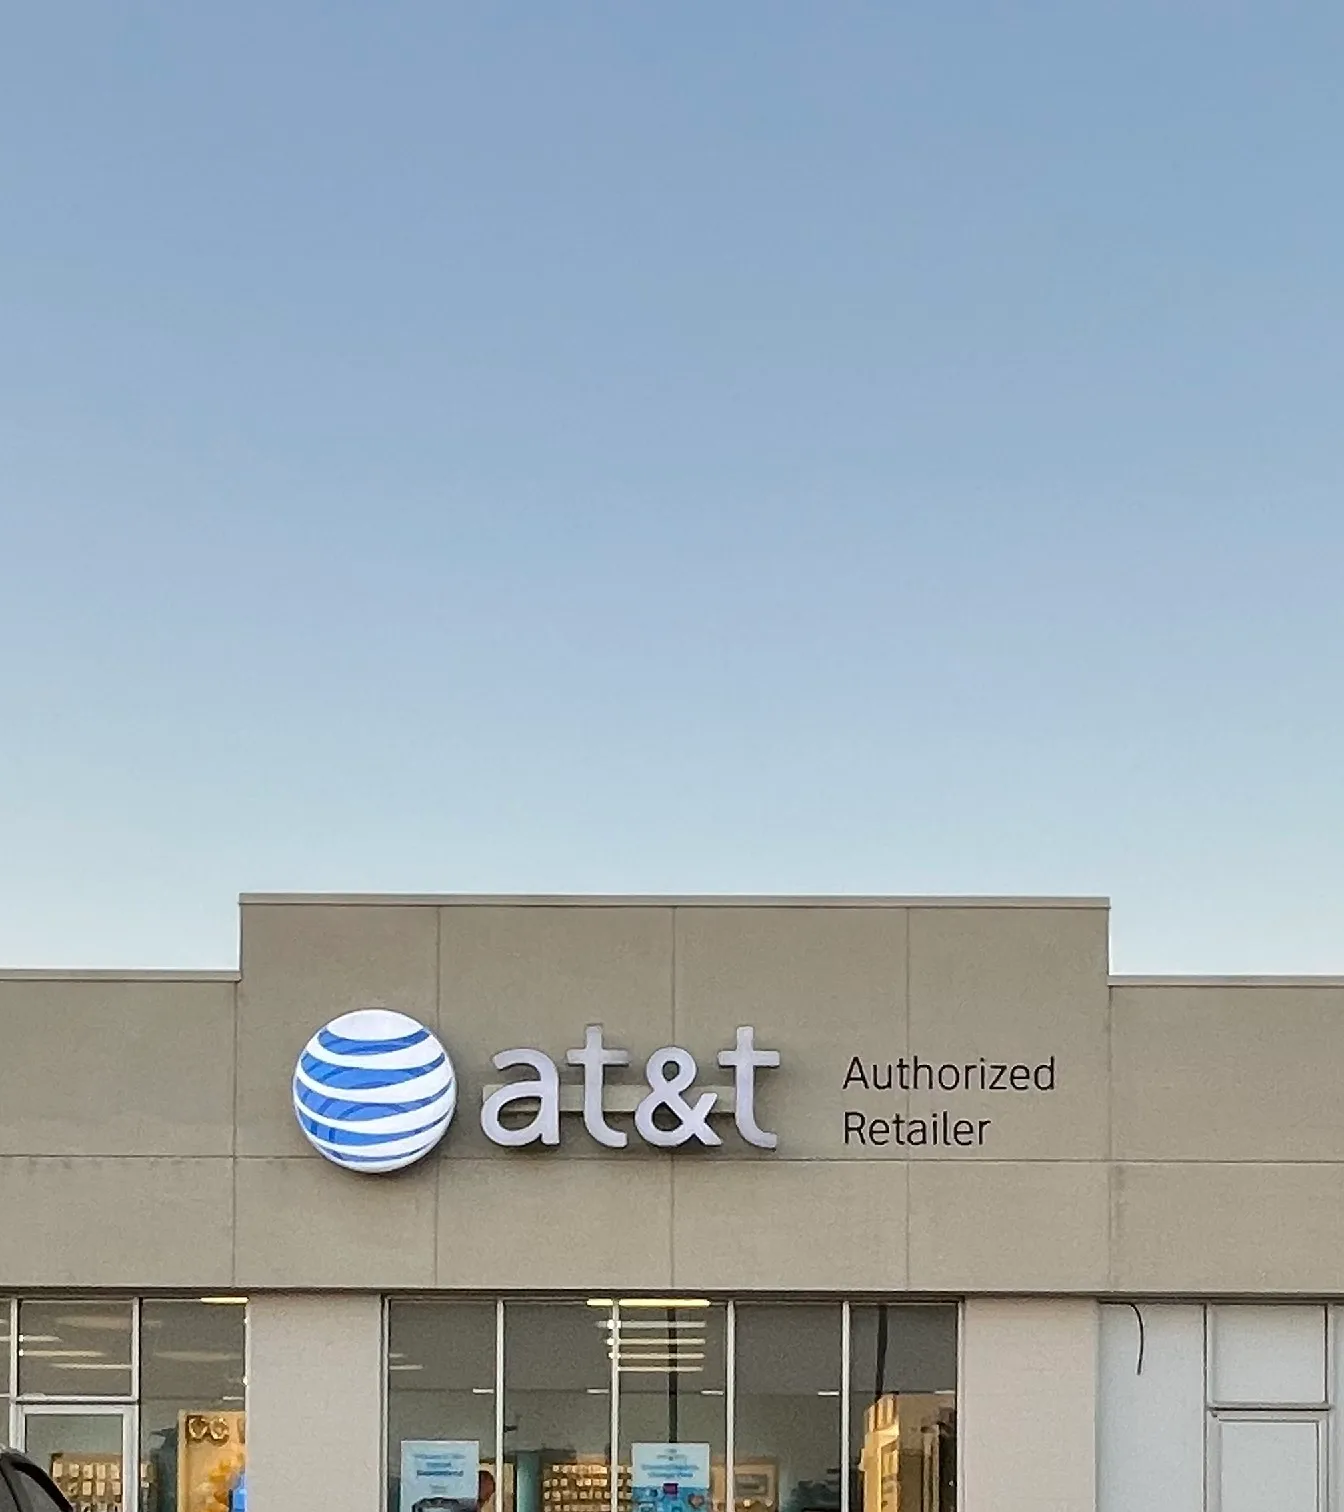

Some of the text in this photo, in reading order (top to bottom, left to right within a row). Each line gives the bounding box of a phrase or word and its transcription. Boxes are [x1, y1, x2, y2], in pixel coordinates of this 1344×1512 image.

[481, 1025, 780, 1149] at&t
[842, 1055, 1055, 1091] Authorized
[844, 1110, 992, 1146] Retailer
